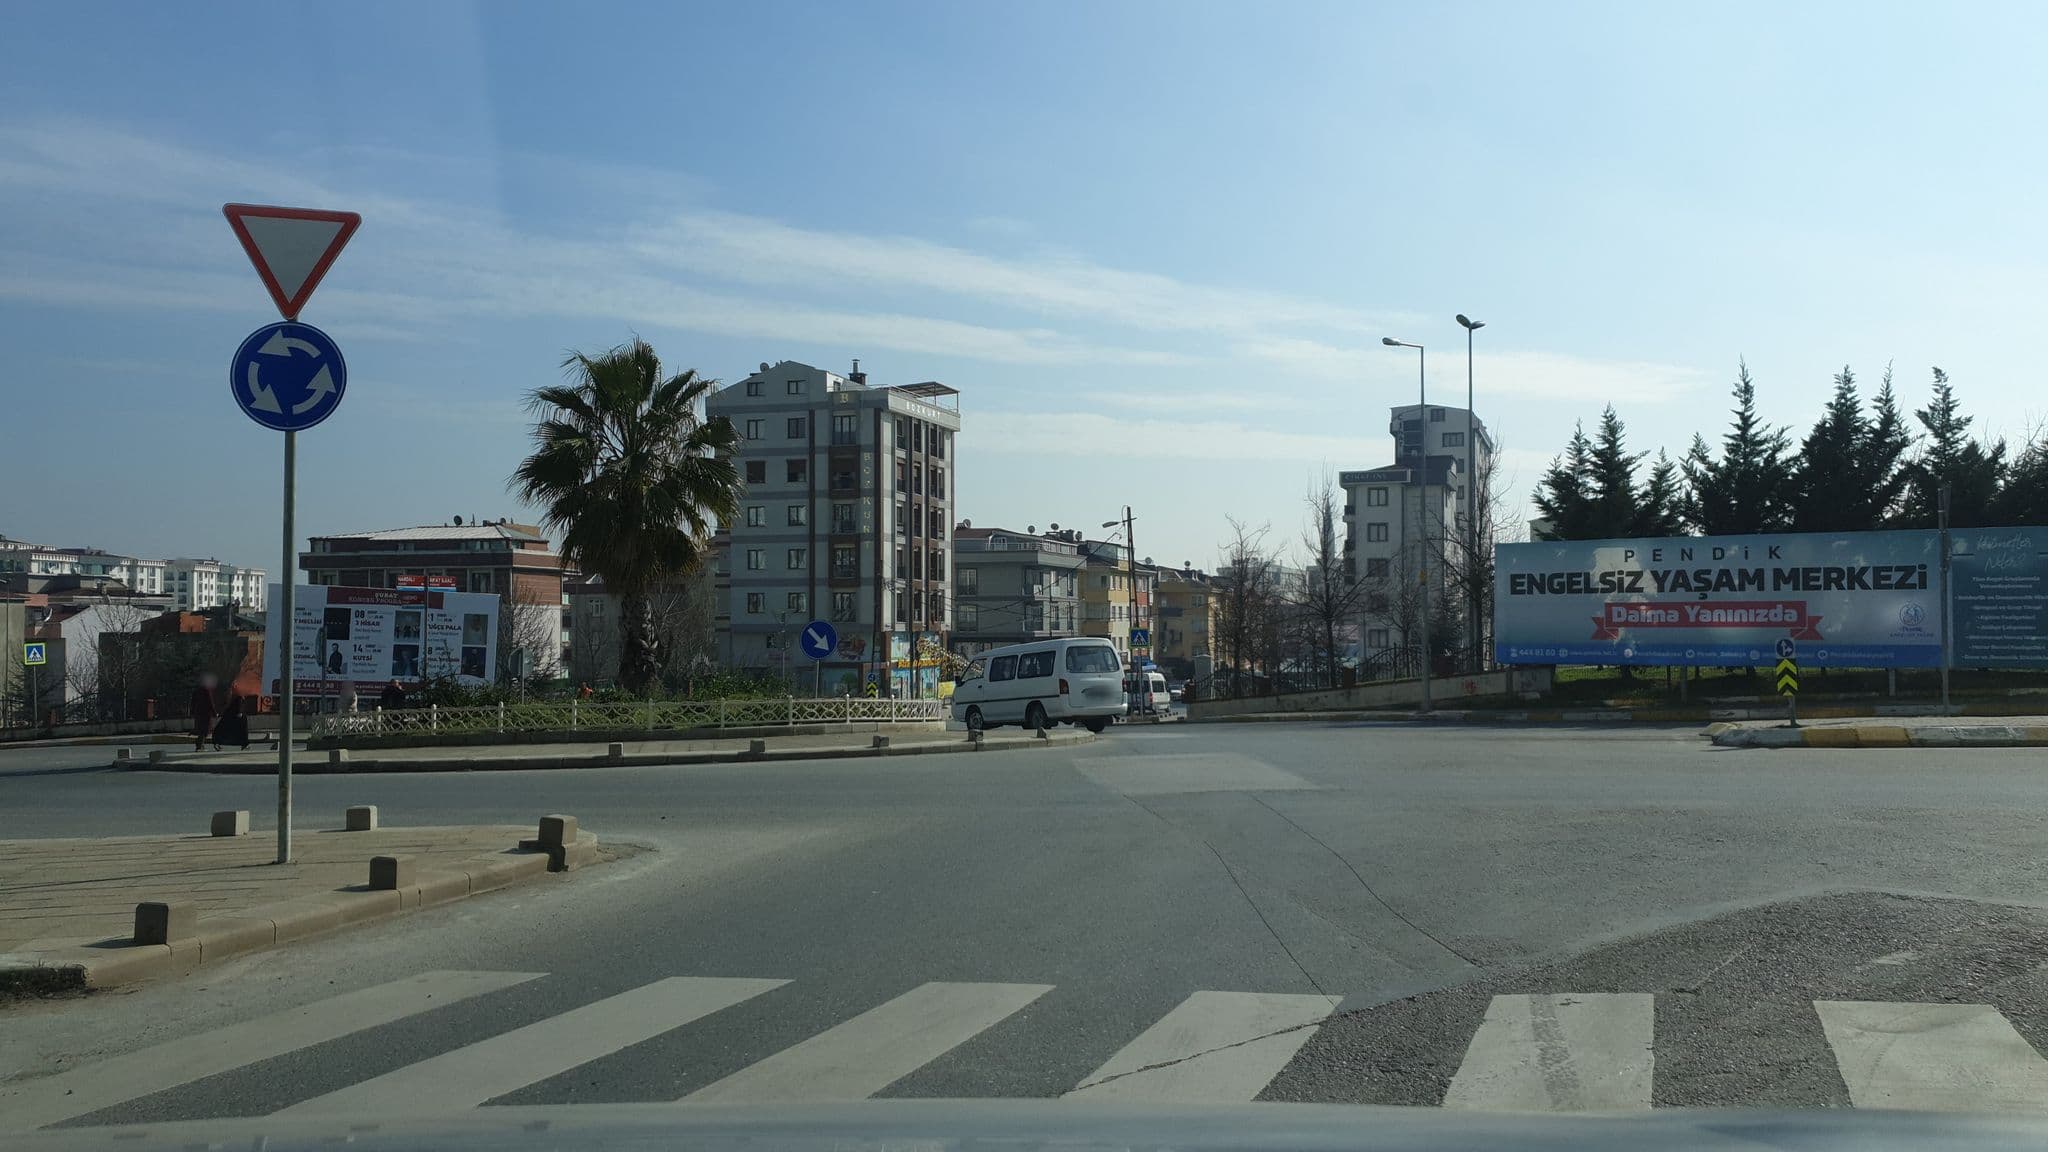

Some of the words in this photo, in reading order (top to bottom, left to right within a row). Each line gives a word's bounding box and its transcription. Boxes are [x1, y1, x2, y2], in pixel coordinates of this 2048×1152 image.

[1649, 568, 1765, 601] YAŞAM
[354, 610, 365, 619] 08
[1611, 604, 1680, 624] Daima
[1684, 603, 1798, 624] Yanınızda
[353, 644, 363, 653] 14
